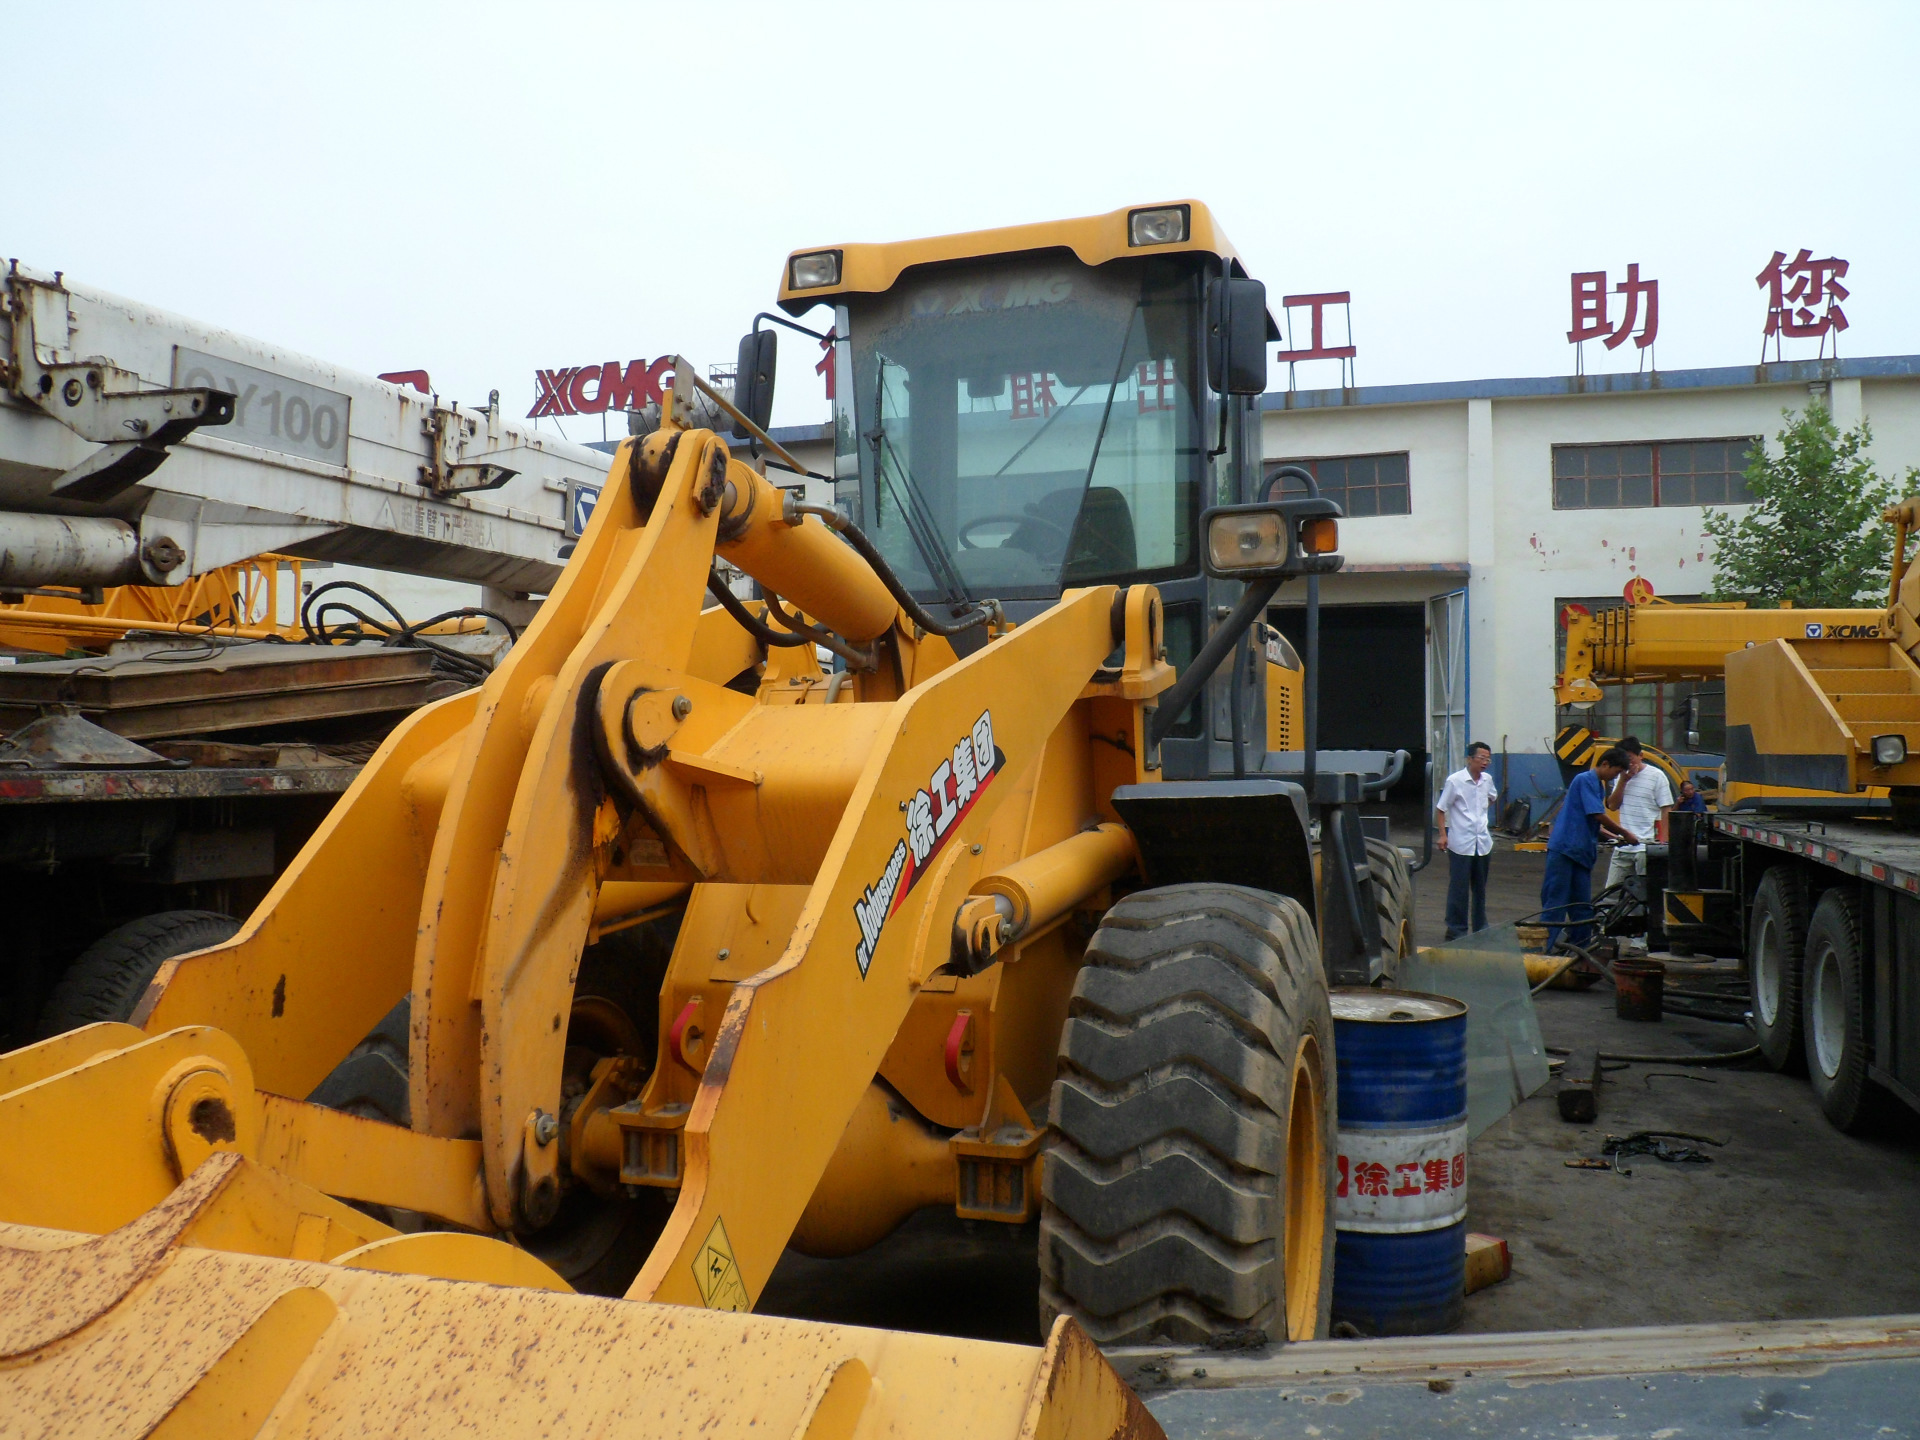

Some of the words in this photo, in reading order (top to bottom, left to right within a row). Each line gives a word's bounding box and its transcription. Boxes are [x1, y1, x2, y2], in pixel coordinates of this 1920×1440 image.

[526, 354, 677, 418] XCMG
[1566, 262, 1659, 351] 助
[1755, 247, 1850, 338] 您
[1824, 625, 1880, 638] XCMG
[906, 709, 996, 868] 徐工集团
[1354, 1152, 1466, 1197] 徐工集团
